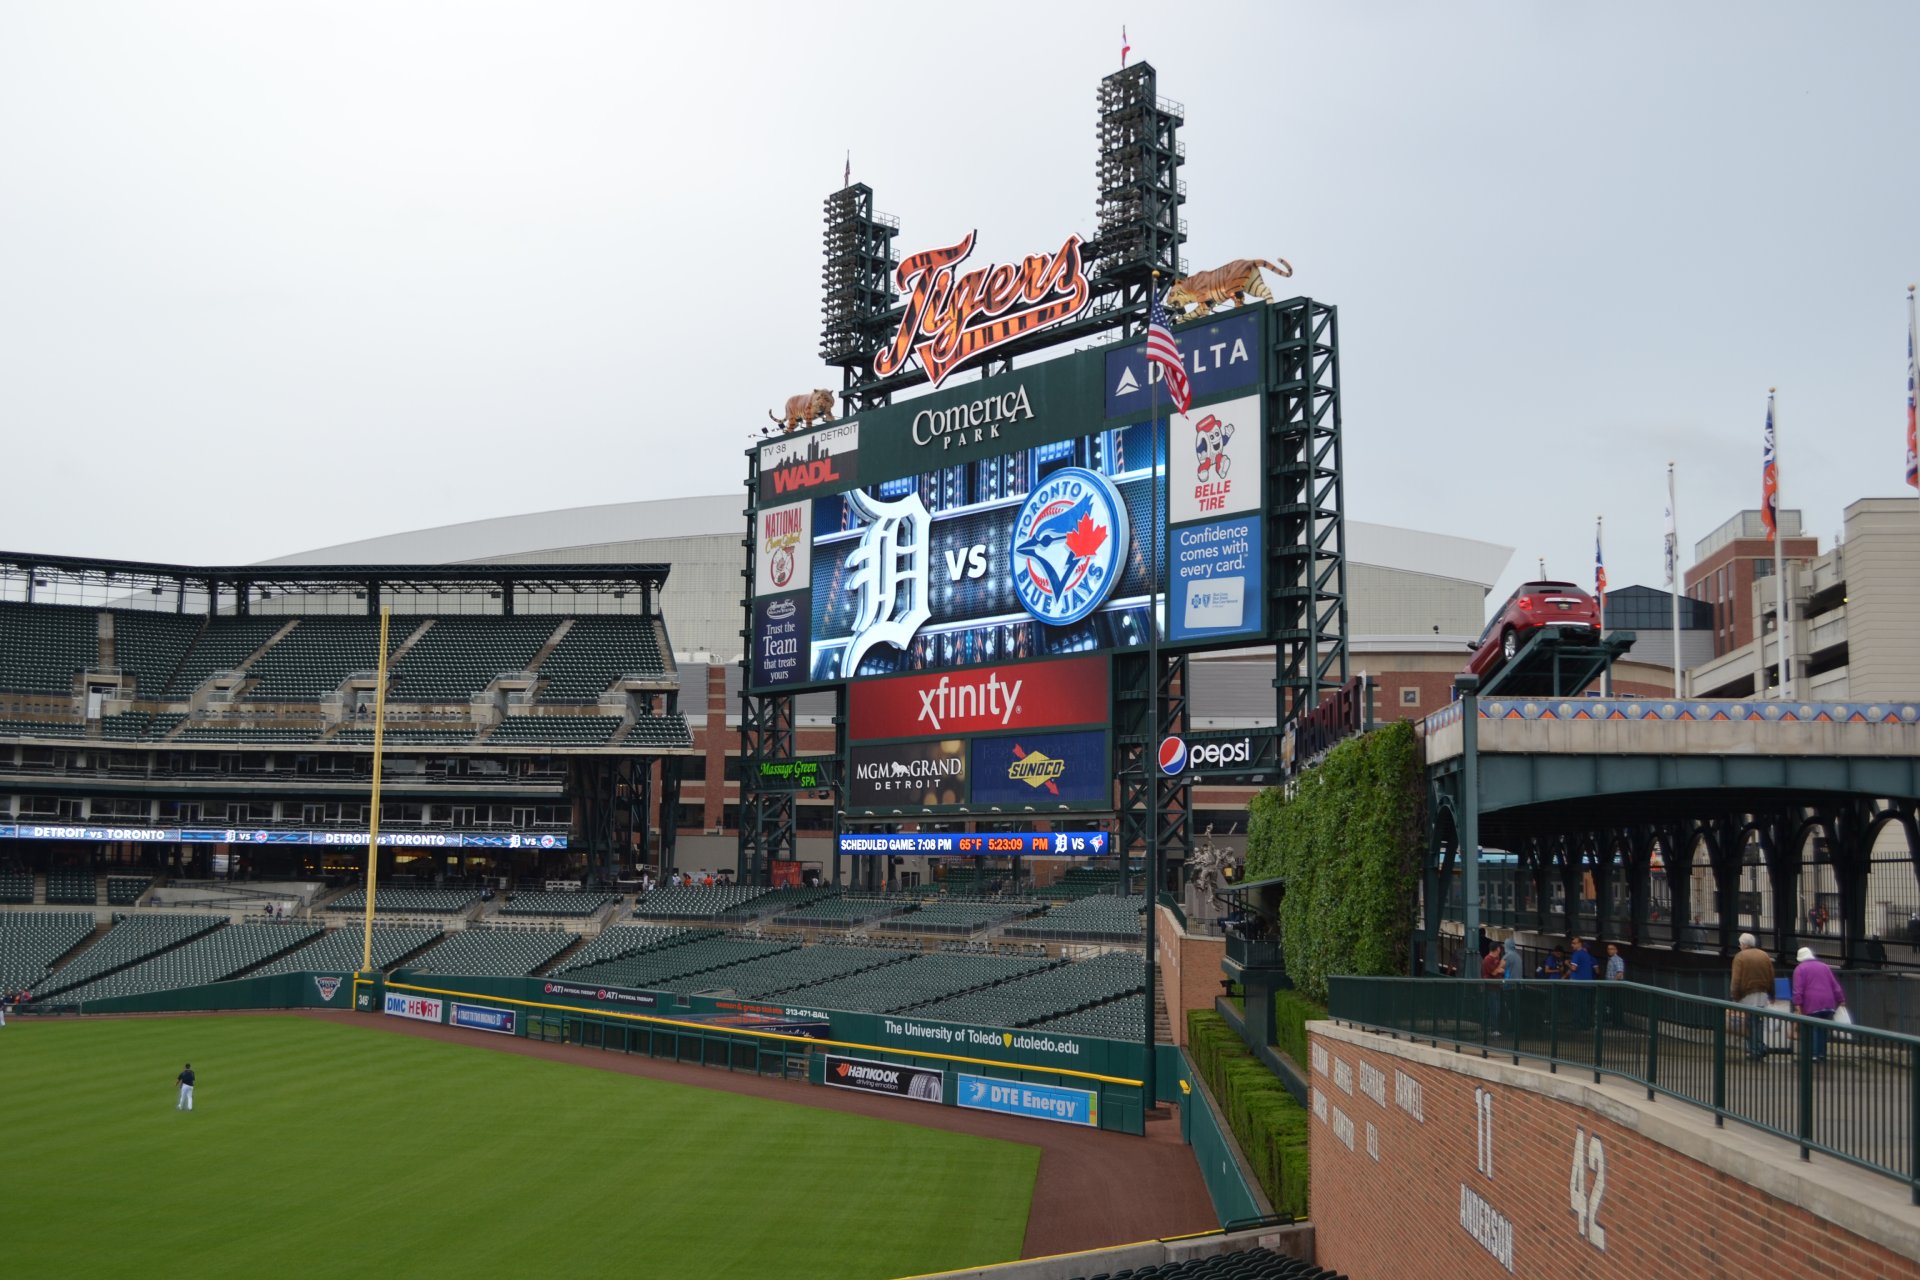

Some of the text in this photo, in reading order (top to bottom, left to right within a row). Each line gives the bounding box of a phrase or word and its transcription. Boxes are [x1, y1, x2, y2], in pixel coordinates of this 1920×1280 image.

[874, 229, 1089, 380] Tigers
[1148, 338, 1249, 385] DLTA
[820, 424, 858, 442] DETROIT
[943, 424, 1000, 450] PARK
[763, 444, 787, 457] TV 38
[773, 458, 840, 494] WADL
[1194, 480, 1231, 499] BELLE
[1018, 481, 1083, 539] TORONTO
[1199, 496, 1226, 512] TIRE
[765, 507, 802, 539] NATIONAL
[1180, 525, 1249, 546] Confidence
[1180, 538, 1249, 562] comes with
[1180, 554, 1246, 578] every card.
[1017, 563, 1104, 614] BLUE JAYS
[766, 622, 795, 635] Trust the
[763, 635, 798, 657] Team
[763, 657, 797, 670] that treats
[770, 671, 789, 683] yours
[918, 672, 1022, 730] xfinity
[1190, 737, 1250, 768] pepsi
[760, 761, 817, 778] Massage Green
[856, 758, 962, 780] MGM GRAND
[1010, 760, 1063, 777] SUNOCO
[801, 776, 816, 787] SPA
[875, 778, 941, 791] DETROIT
[34, 827, 86, 838] DETROIT
[107, 828, 165, 840] TORONTO
[325, 834, 371, 844] DETROIT
[390, 835, 446, 845] TORONTO
[841, 839, 952, 850] SCHEDULED GAME: 7:08 PM
[988, 838, 1023, 850] 5:23:09
[1032, 838, 1048, 850] PM
[1071, 838, 1085, 850] VS
[552, 985, 564, 994] ATI
[606, 991, 618, 1000] ATI
[387, 997, 406, 1012] DMC
[785, 1008, 830, 1019] 313-471-BALL
[885, 1020, 1080, 1055] The University of Toledo utoledo.edu
[856, 1079, 898, 1090] driving emotion
[990, 1086, 1076, 1117] DTE Energy
[1475, 1086, 1493, 1181] 11
[1569, 1125, 1606, 1253] 42
[1460, 1182, 1513, 1275] ANDERSON
